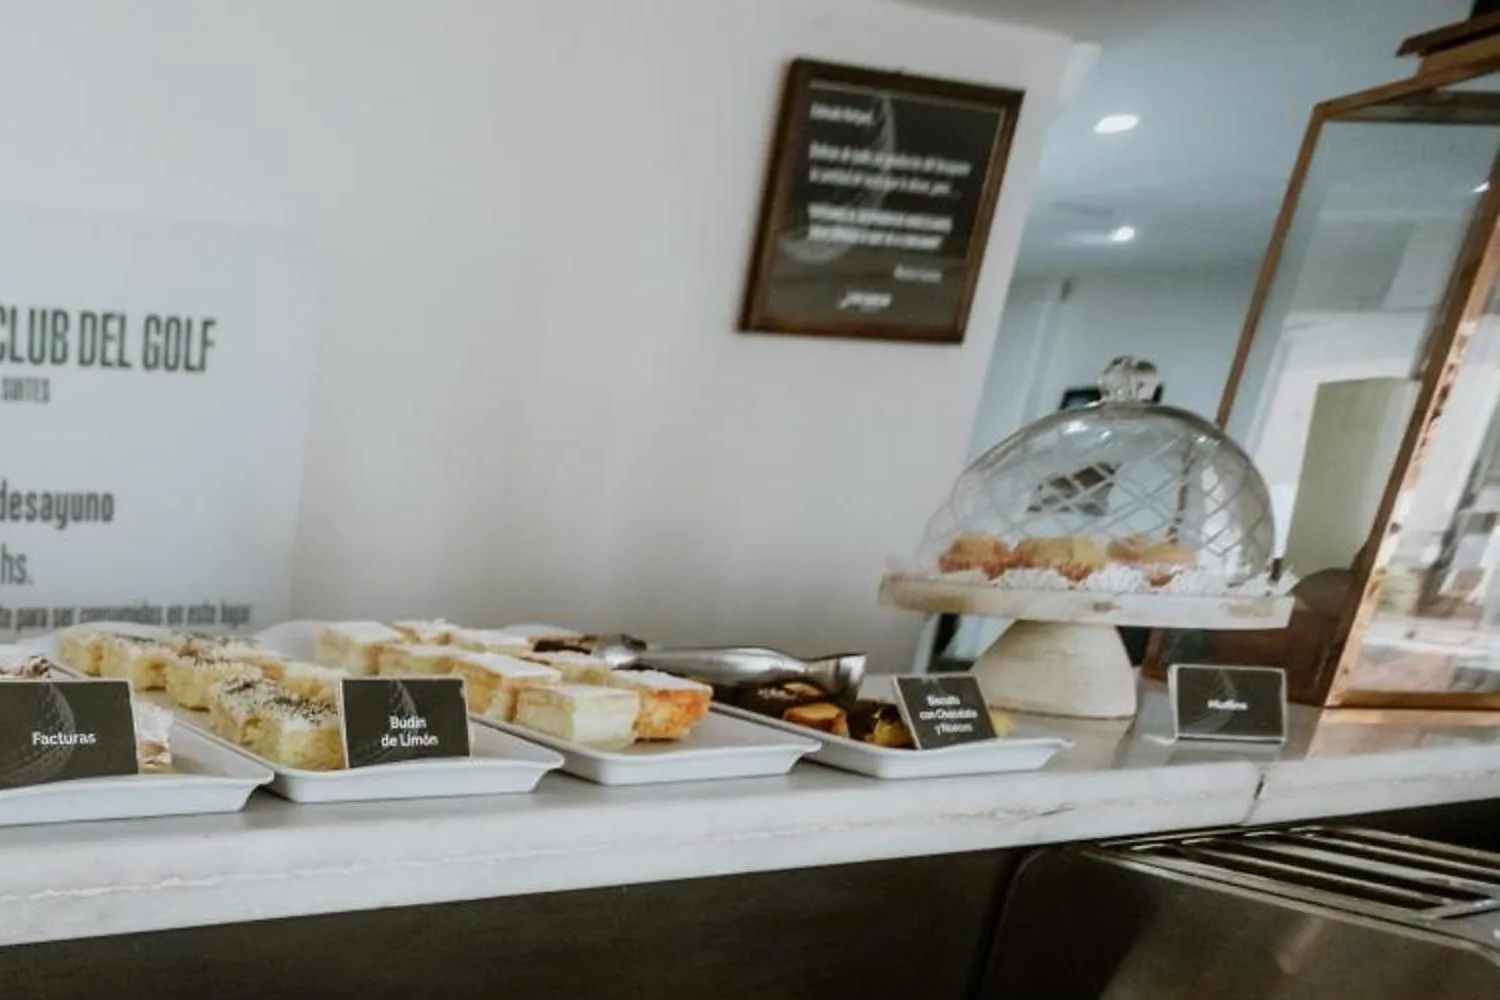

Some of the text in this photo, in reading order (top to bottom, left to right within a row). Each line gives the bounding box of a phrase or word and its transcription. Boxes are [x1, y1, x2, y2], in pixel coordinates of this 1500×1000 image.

[77, 309, 132, 369] DEL
[141, 313, 218, 373] GOLF
[1, 376, 51, 402] SUITES
[0, 542, 35, 586] hs.
[31, 730, 97, 746] Facturas
[381, 732, 398, 748] de
